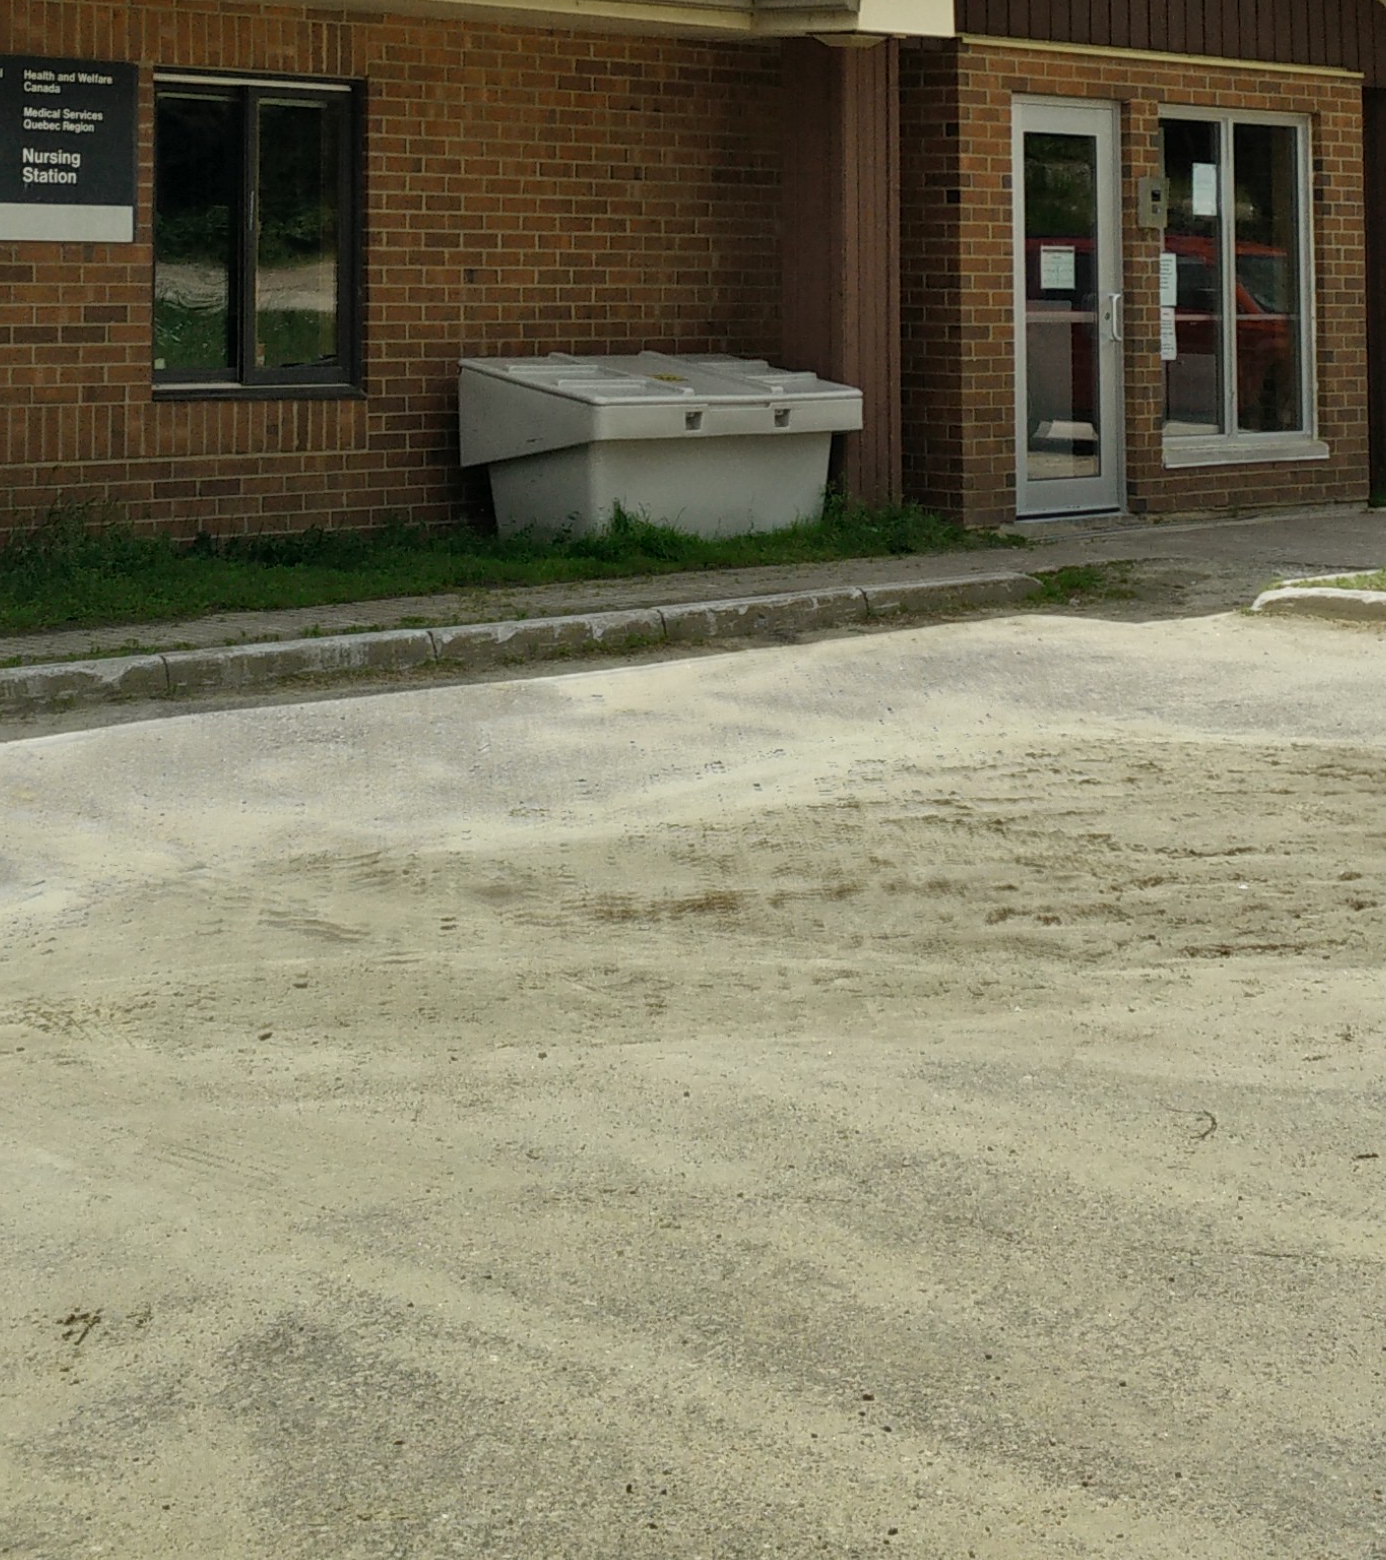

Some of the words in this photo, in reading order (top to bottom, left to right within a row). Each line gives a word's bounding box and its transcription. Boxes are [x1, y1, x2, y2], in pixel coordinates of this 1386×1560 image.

[23, 69, 55, 80] Health
[57, 73, 76, 82] and
[78, 72, 113, 85] Welfare
[23, 81, 61, 93] Canada
[23, 107, 61, 118] Medical
[62, 108, 103, 120] Services
[23, 119, 61, 130] Quebec
[62, 121, 95, 133] Region
[22, 147, 81, 168] Nursing
[22, 166, 77, 184] Station
